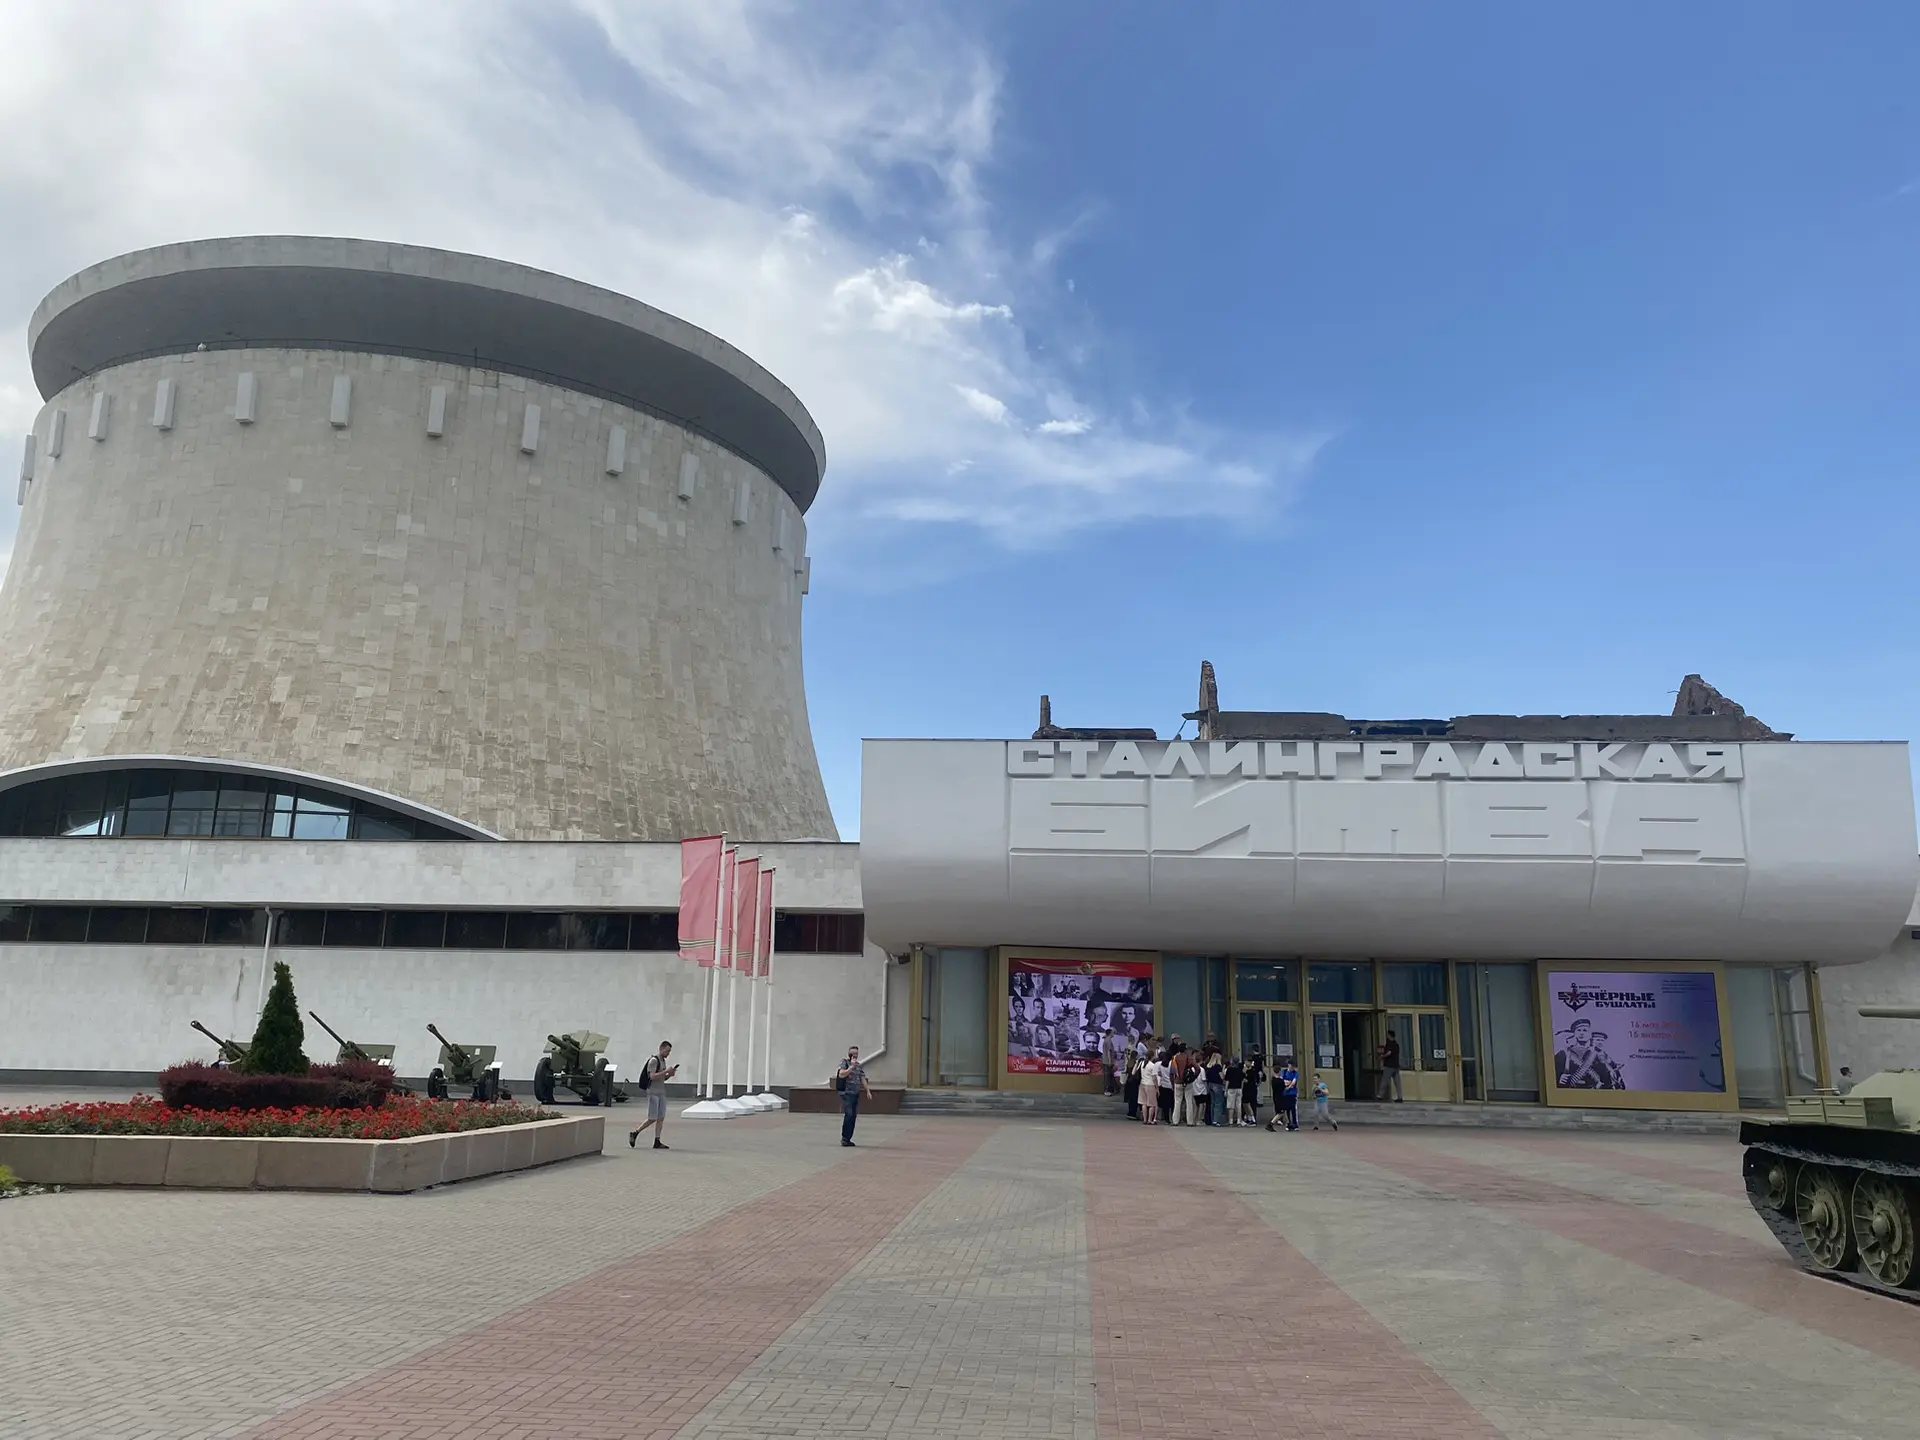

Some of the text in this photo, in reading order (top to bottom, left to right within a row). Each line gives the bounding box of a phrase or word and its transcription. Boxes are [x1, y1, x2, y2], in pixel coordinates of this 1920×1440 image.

[1007, 741, 1744, 780] СТАЛИНГРАДСКАЯ
[1588, 989, 1656, 1001] ЧЁРНЫЕ
[1595, 1001, 1656, 1009] БУШЛАТЫ
[1045, 1059, 1086, 1067] СТАЛИНГРАД
